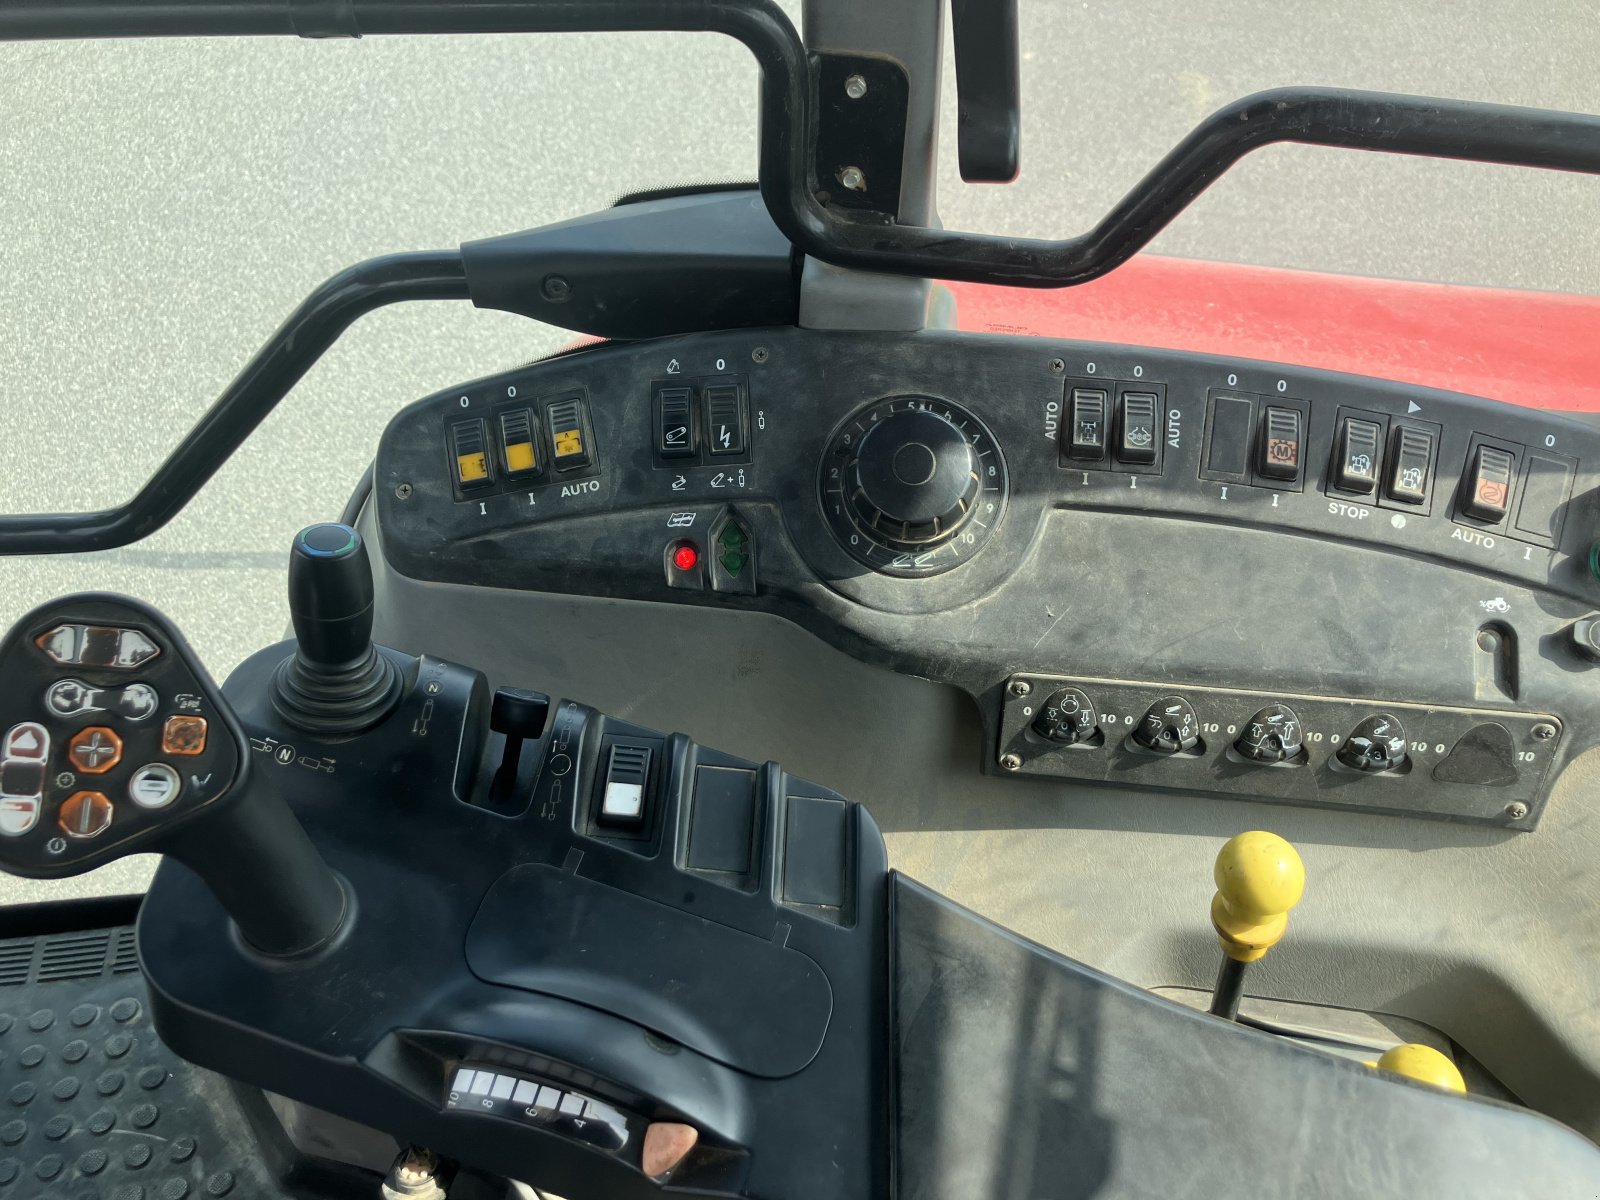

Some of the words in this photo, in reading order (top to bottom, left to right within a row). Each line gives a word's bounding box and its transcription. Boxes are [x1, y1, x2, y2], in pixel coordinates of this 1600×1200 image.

[716, 358, 726, 371] 0
[1086, 362, 1096, 374] 0
[1133, 365, 1143, 377] 0
[1227, 373, 1237, 386] 0
[1277, 379, 1287, 392] 0
[507, 386, 517, 398] 0
[460, 396, 470, 408] 0
[907, 401, 915, 410] 5
[870, 412, 878, 422] 4
[944, 410, 952, 421] 6
[1044, 401, 1058, 441] AUTO
[1167, 409, 1181, 448] AUTO
[843, 434, 851, 445] 3
[972, 434, 981, 445] 7
[1544, 434, 1556, 447] 0
[1276, 445, 1289, 459] M
[831, 468, 839, 479] 2
[988, 465, 996, 477] 8
[560, 480, 600, 498] AUTO
[834, 504, 840, 515] 1
[986, 503, 994, 514] 9
[1327, 502, 1370, 521] STOP
[850, 534, 859, 545] 0
[961, 533, 975, 544] 10
[1451, 527, 1496, 549] AUTO
[1023, 706, 1032, 716] 0
[1100, 713, 1116, 724] 10
[1124, 715, 1134, 725] 0
[1061, 721, 1068, 730] 0
[1203, 722, 1219, 733] 10
[1226, 724, 1236, 734] 0
[1163, 730, 1171, 740] 0
[1306, 731, 1323, 742] 10
[1330, 733, 1340, 744] 0
[1410, 741, 1428, 752] 10
[1435, 743, 1445, 753] 0
[278, 748, 292, 761] N
[1374, 751, 1382, 760] 3
[1517, 751, 1535, 762] 10
[482, 1098, 494, 1109] 8
[574, 1117, 587, 1128] 4
